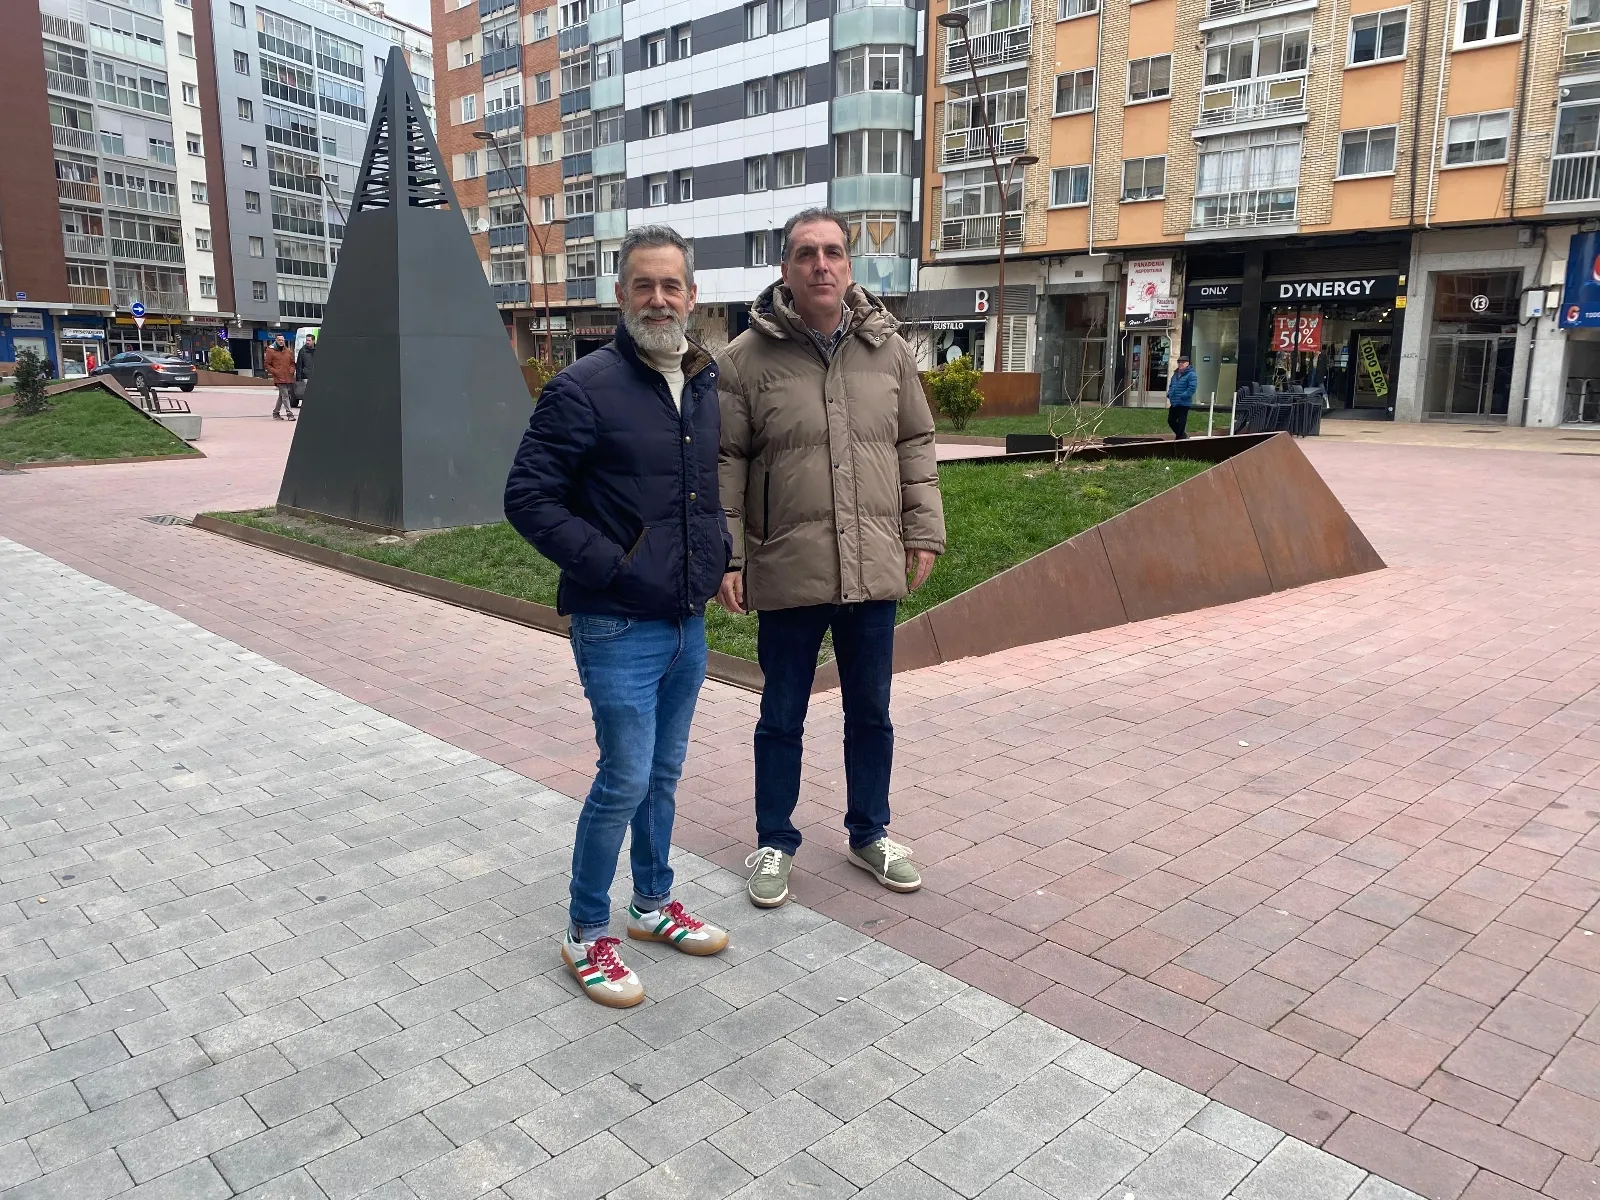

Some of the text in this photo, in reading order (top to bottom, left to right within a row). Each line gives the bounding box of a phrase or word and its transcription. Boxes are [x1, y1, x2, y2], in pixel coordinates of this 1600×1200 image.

[1201, 286, 1229, 296] ONLY
[1280, 280, 1376, 298] DYNERGY
[974, 289, 990, 313] B
[1473, 298, 1486, 309] 13
[933, 322, 964, 330] BUSTILLO
[1279, 328, 1314, 348] 50%
[1361, 340, 1388, 393] TODO 50%
